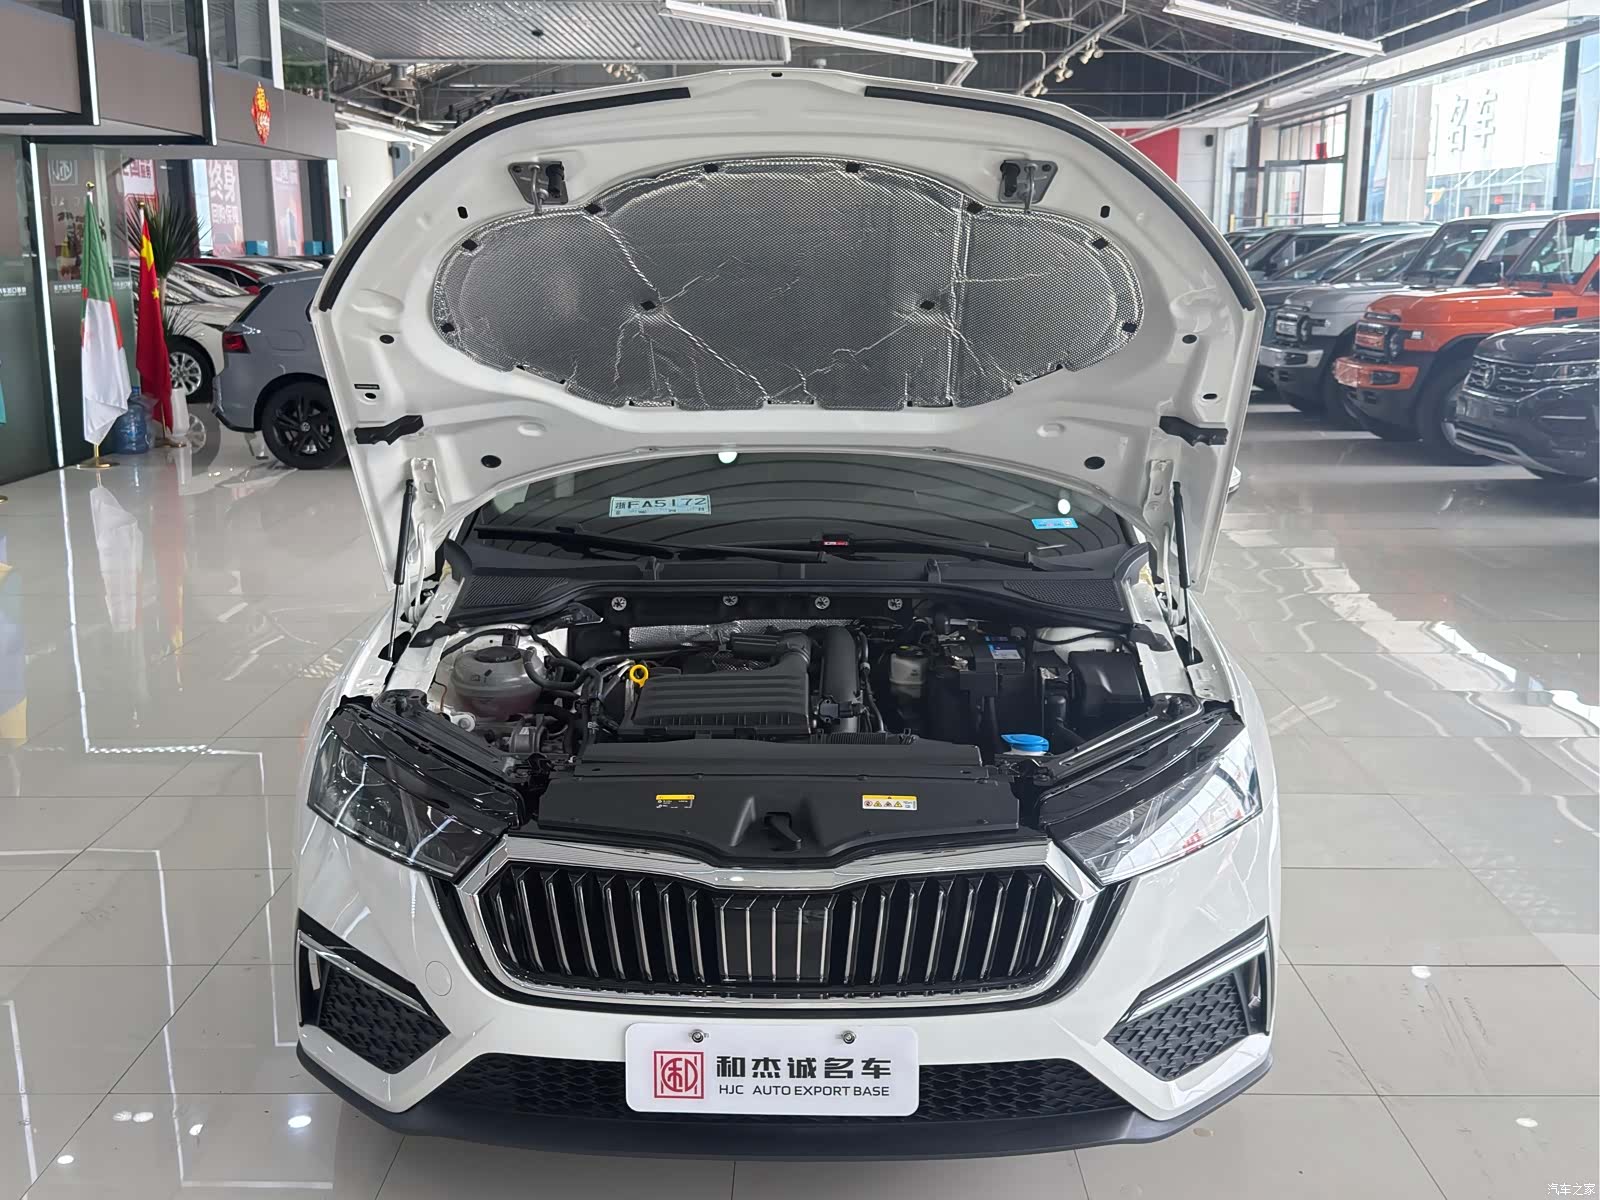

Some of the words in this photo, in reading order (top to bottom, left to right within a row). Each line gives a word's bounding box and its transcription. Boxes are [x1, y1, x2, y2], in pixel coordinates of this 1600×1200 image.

[1434, 88, 1498, 156] 名车
[716, 1055, 892, 1080] 和杰诚名车
[719, 1084, 745, 1095] HJC
[752, 1085, 791, 1096] AUTO
[794, 1086, 851, 1097] EXPORT
[853, 1086, 890, 1097] BASE
